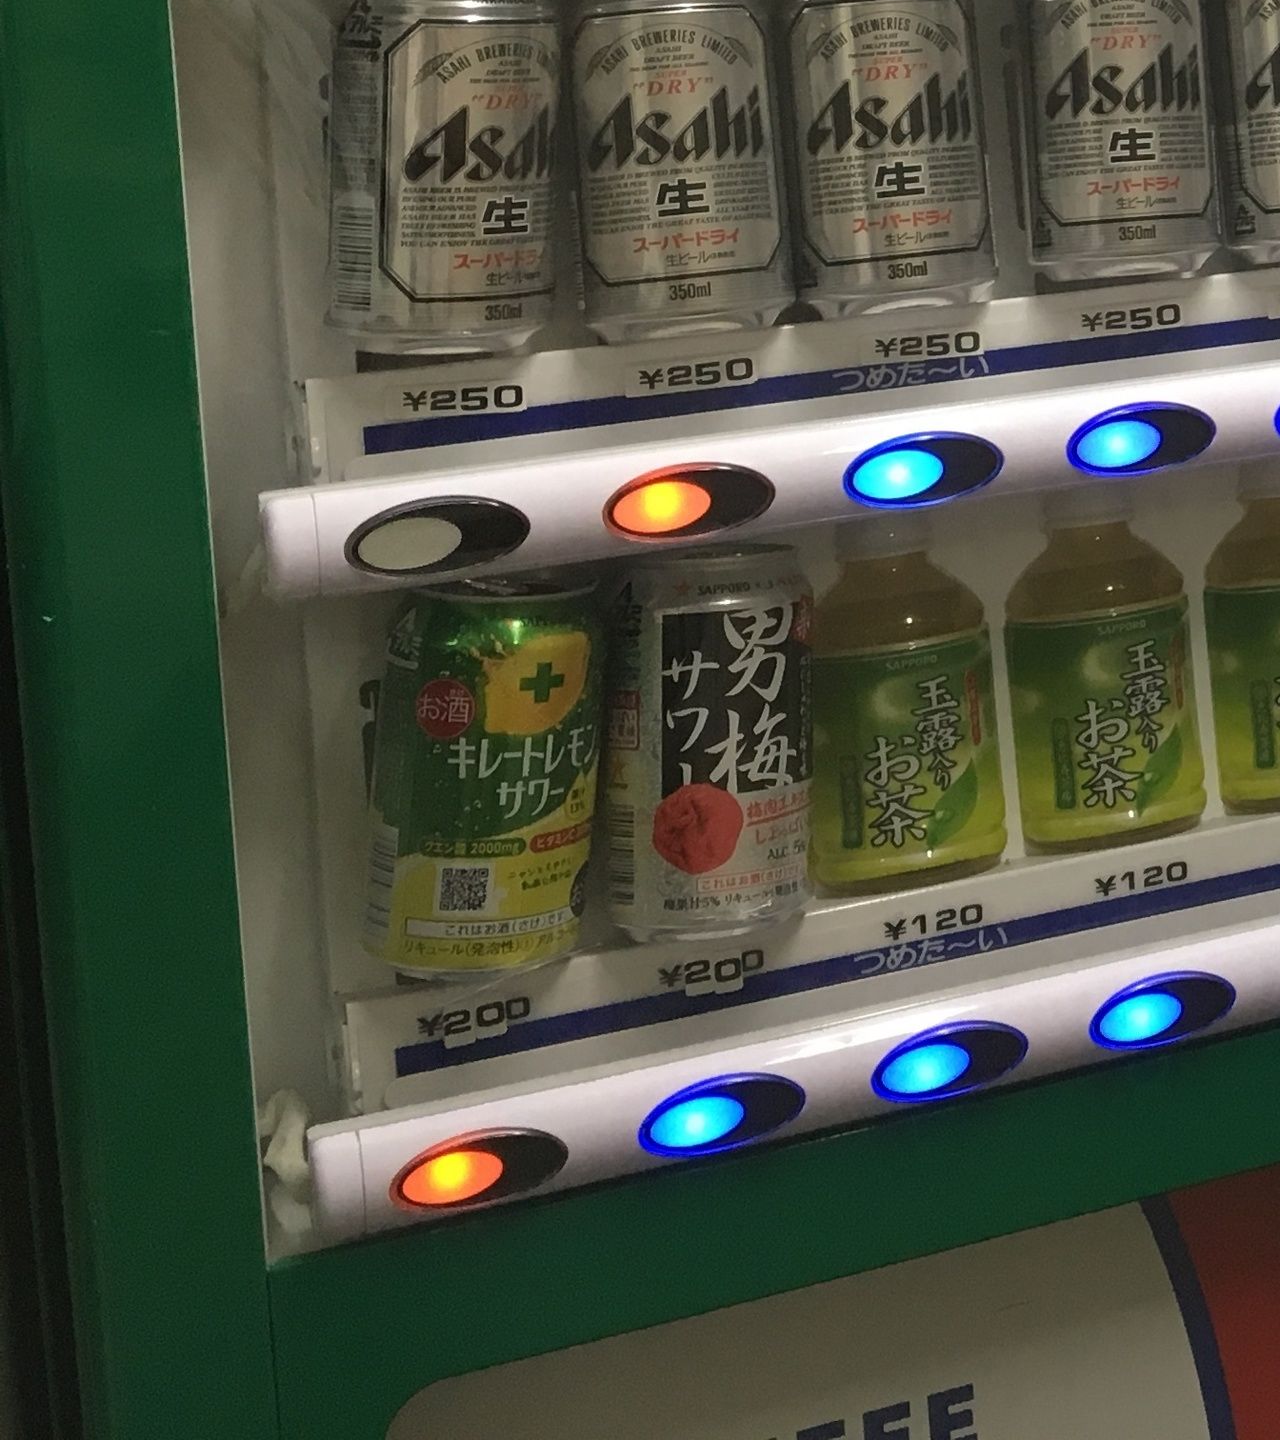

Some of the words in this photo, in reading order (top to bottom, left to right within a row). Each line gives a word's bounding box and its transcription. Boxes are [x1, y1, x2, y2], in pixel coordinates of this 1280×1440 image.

[601, 46, 629, 75] ASAHI
[632, 29, 696, 51] BREWERIES
[701, 35, 738, 65] LIMITED
[1046, 42, 1200, 120] Asahi
[587, 84, 765, 171] Asahi
[807, 71, 971, 156] Asahi
[1109, 128, 1156, 163] 生
[656, 179, 710, 217] 生
[875, 162, 925, 198] 生
[482, 196, 529, 235] 生
[853, 210, 952, 233] スーパードライ
[1119, 226, 1156, 241] 350ml
[633, 228, 739, 253] スーパードライ
[888, 261, 927, 279] 350ml
[669, 282, 711, 301] 350ml
[1082, 304, 1180, 331] ¥250
[875, 330, 981, 358] ¥250
[639, 357, 754, 388] ¥250
[403, 385, 523, 411] ¥250
[416, 693, 469, 725] お酒
[705, 605, 798, 793] 男梅
[1076, 697, 1141, 809] お茶
[496, 779, 565, 820] サワー
[866, 735, 935, 847] お茶
[1095, 861, 1188, 896] ¥120
[886, 903, 983, 939] ¥120
[658, 950, 764, 988] ¥200
[417, 997, 531, 1037] ¥200
